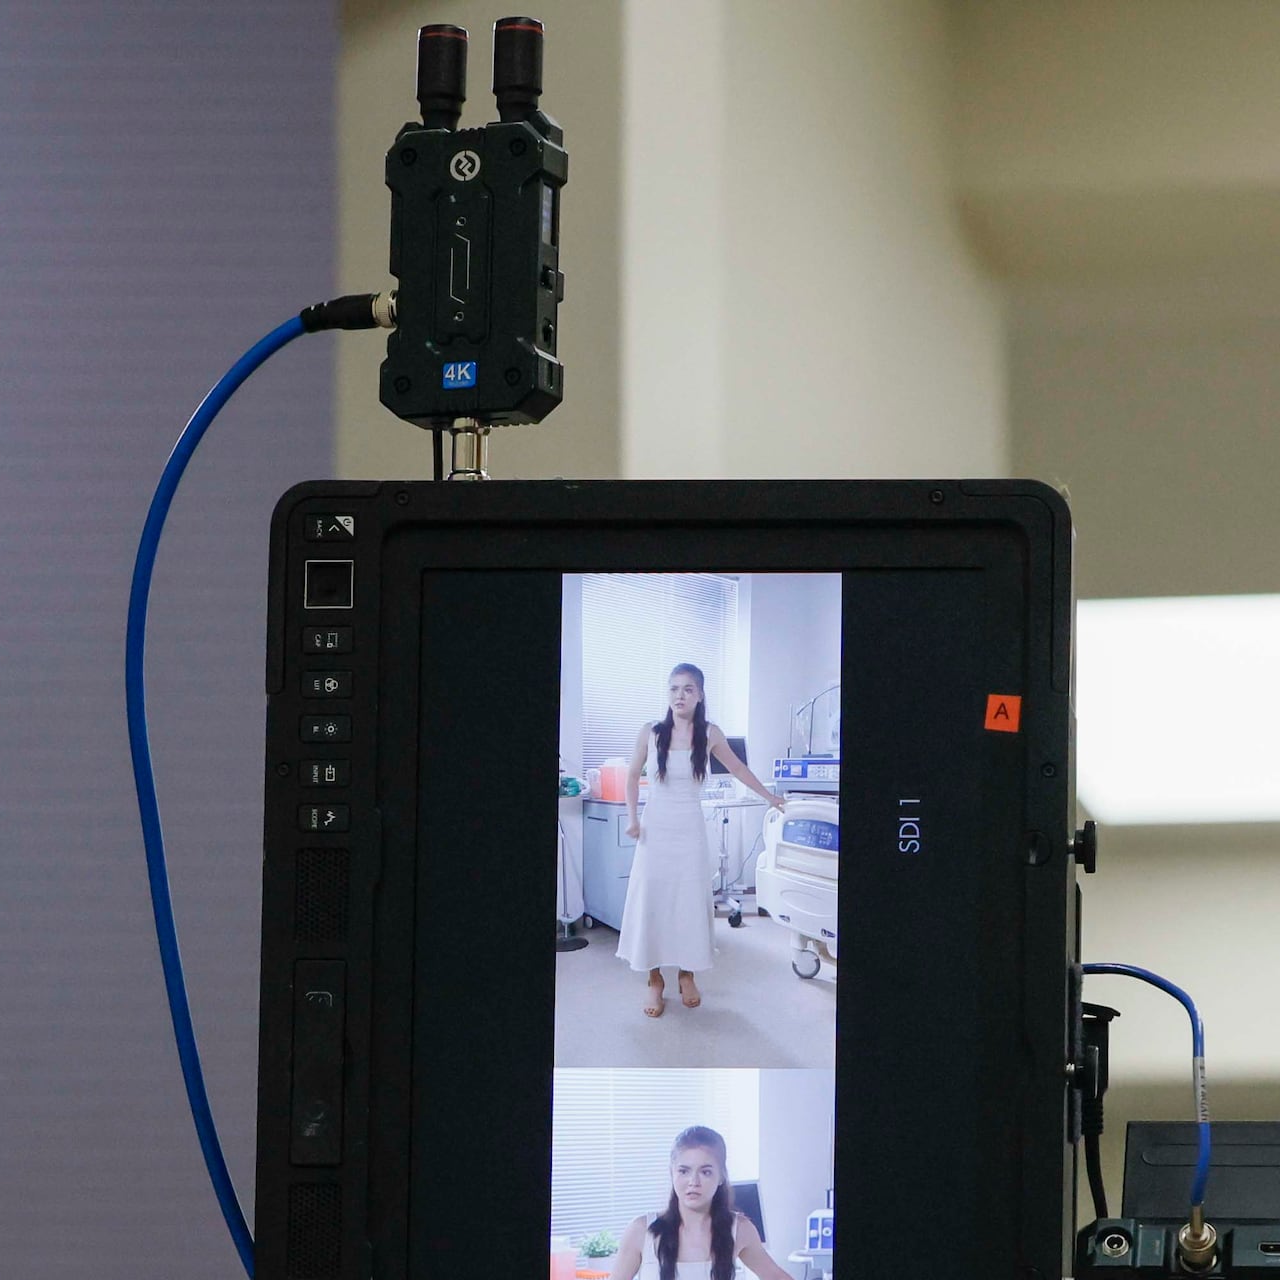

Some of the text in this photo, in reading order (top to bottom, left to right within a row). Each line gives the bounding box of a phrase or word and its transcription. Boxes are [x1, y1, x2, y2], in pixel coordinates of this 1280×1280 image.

[444, 362, 472, 381] 4K
[315, 518, 324, 538] BACK
[313, 632, 322, 648] CAP
[312, 678, 321, 692] LUT
[993, 702, 1010, 720] A
[311, 764, 320, 784] INPUT
[310, 808, 319, 829] SCOPE
[898, 818, 920, 853] SDI
